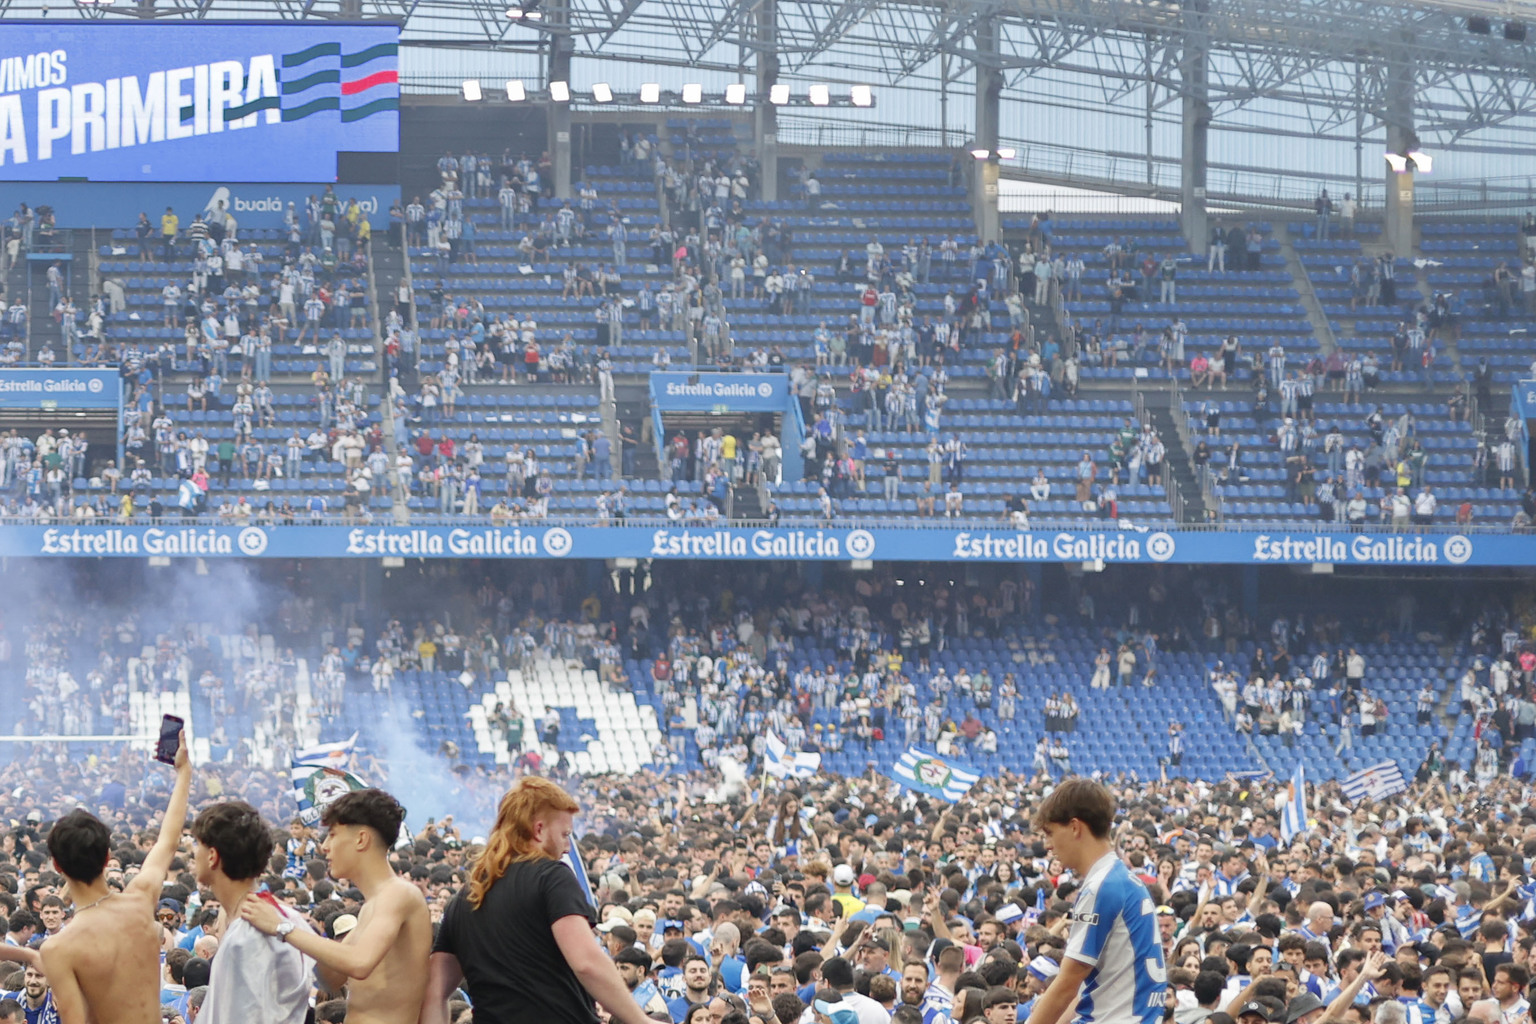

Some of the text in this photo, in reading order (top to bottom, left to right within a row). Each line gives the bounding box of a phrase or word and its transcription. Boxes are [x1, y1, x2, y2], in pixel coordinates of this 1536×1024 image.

[37, 54, 282, 162] PRIMEIRA
[234, 196, 280, 212] bualá
[43, 379, 86, 392] Galicia
[666, 382, 755, 397] Estrella Galicia
[41, 528, 232, 554] Estrella Galicia
[347, 529, 536, 555] Estrella Galicia
[650, 529, 839, 557] Estrella Galicia
[953, 530, 1140, 559] Estrella Galicia
[1252, 532, 1438, 563] Estrella Galicia
